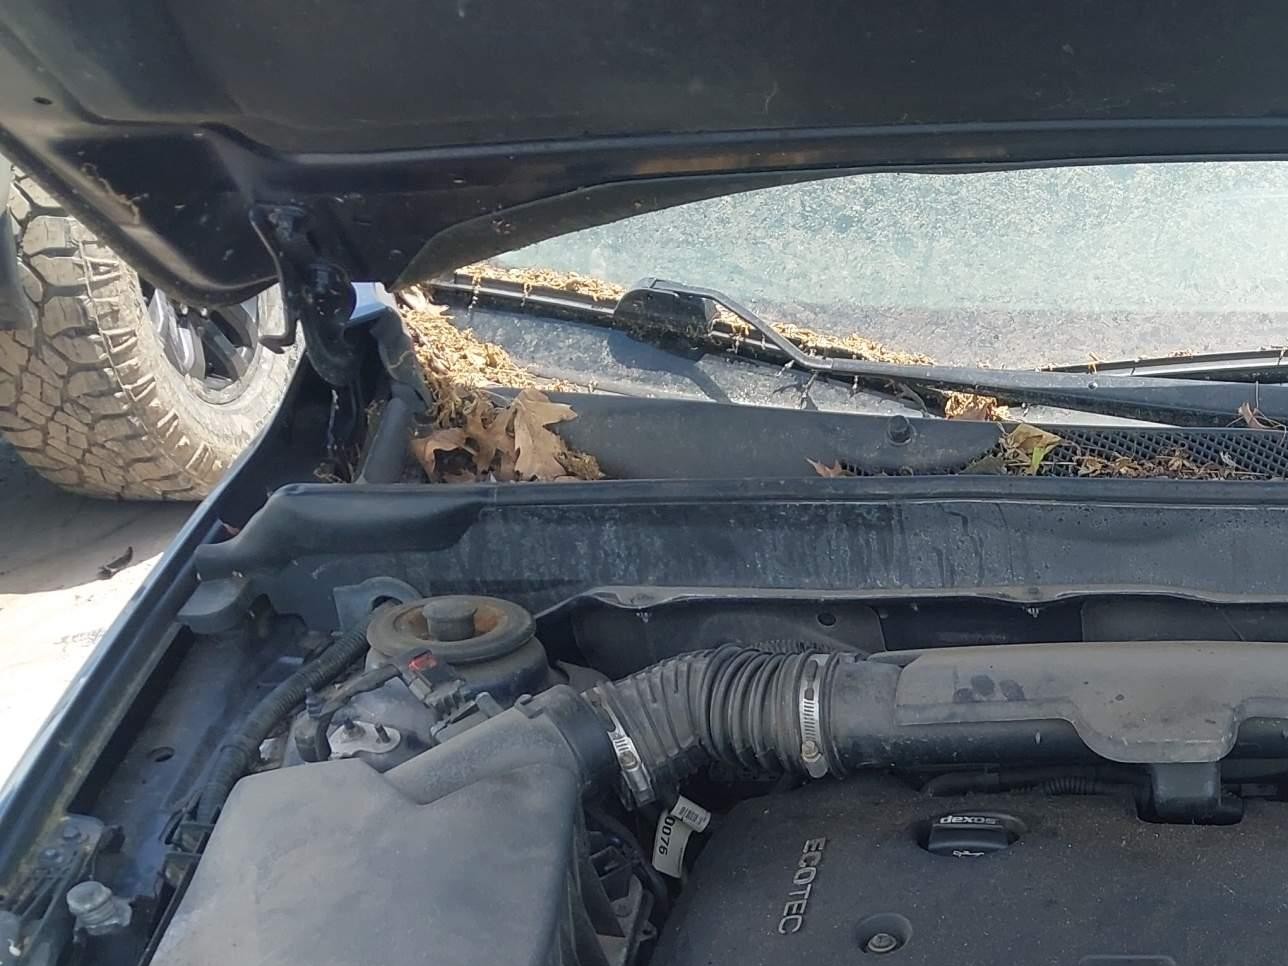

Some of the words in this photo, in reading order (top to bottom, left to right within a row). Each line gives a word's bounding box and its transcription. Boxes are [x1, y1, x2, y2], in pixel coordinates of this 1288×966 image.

[658, 816, 676, 856] 0076
[940, 815, 999, 825] dexos
[778, 837, 826, 935] ECOTEC
